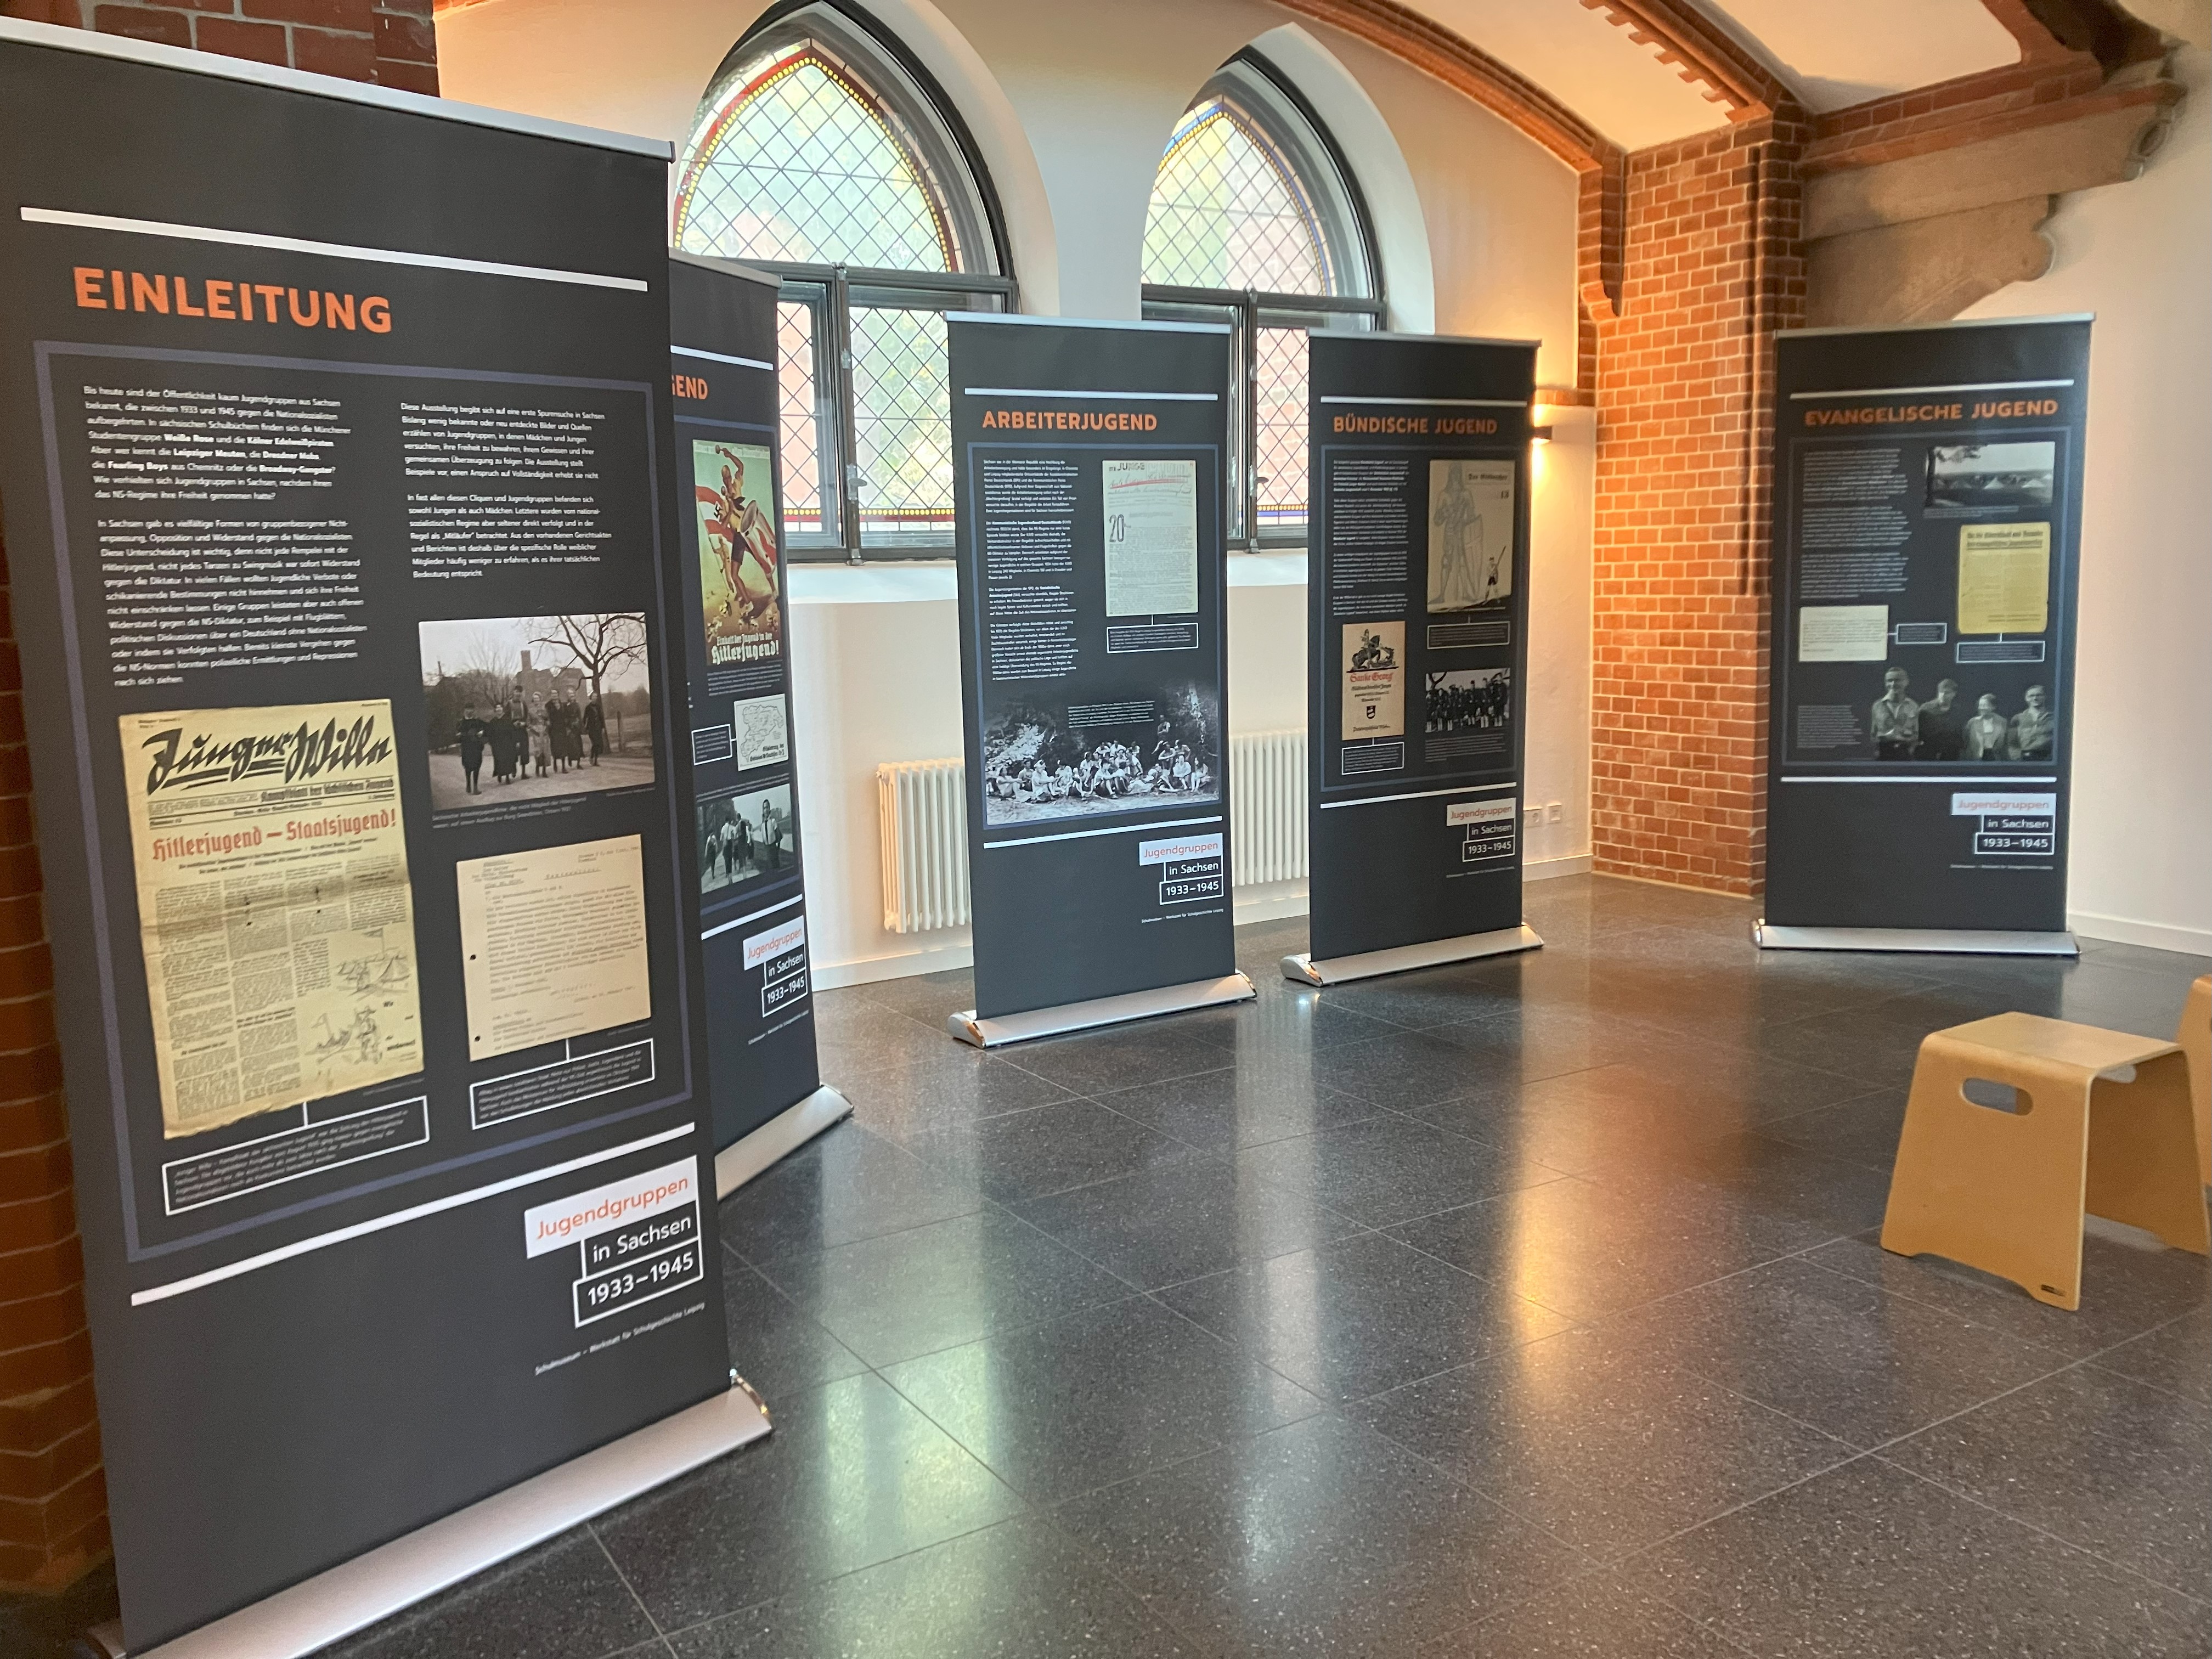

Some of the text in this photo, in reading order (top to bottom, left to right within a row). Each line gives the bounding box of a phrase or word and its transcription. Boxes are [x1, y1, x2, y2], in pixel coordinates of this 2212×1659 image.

[73, 266, 392, 334] EINLEITUNG
[982, 410, 1158, 431] ARBEITERJUGEND
[1804, 399, 2059, 426] EVANGELISCHE JUGEND
[1333, 413, 1498, 435] BÜNDISCHE JUGEND
[1451, 806, 1513, 820] Jugendgruppen
[1958, 800, 2049, 810] Jugendgruppen
[1471, 824, 1512, 836] in Sachsen
[1988, 819, 2049, 828] in Sachsen
[153, 826, 262, 861] Hitlerjugend
[286, 809, 397, 842] Staatsjugend!
[1983, 838, 2049, 848] 1933–1945
[1144, 842, 1218, 859] Jugendgruppen
[1468, 840, 1512, 854] 1933–1945
[1169, 862, 1219, 876] in Sachsen
[1166, 881, 1219, 896] 1933–1945
[747, 928, 802, 960] Jugendgruppen
[768, 953, 804, 977] in Sachsen
[767, 976, 805, 1005] 1933–1945
[537, 1177, 689, 1239] Jugendgruppen
[593, 1217, 691, 1263] in Sachsen
[588, 1251, 694, 1306] 1933–1945
